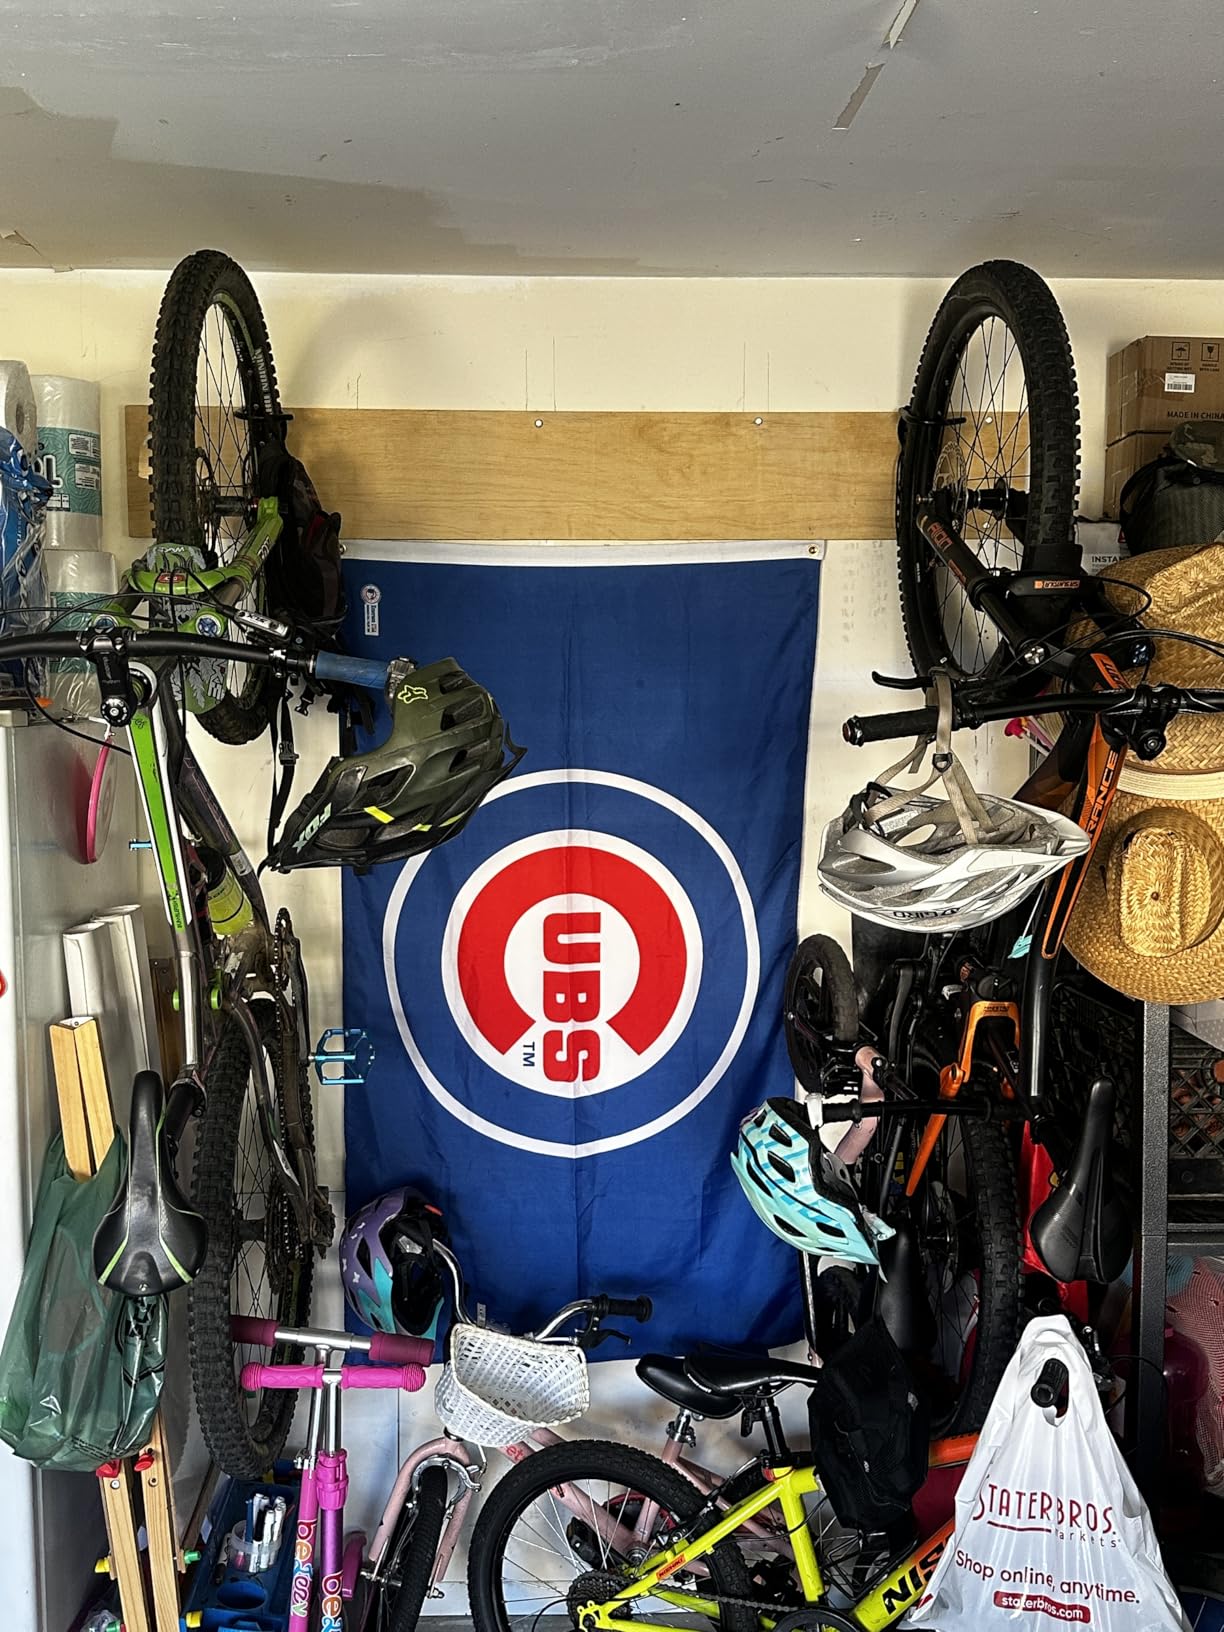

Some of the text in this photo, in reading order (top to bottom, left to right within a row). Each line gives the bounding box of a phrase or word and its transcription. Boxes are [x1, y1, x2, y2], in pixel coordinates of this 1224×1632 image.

[1086, 749, 1119, 836] RANCE
[292, 802, 332, 854] FOX
[523, 1041, 536, 1067] TM
[972, 1483, 1052, 1521] STATER
[882, 1534, 953, 1616] NIS
[955, 1550, 994, 1582] Shop
[1060, 1580, 1140, 1604] anytime.
[1002, 1596, 1084, 1620] staterbros.com
